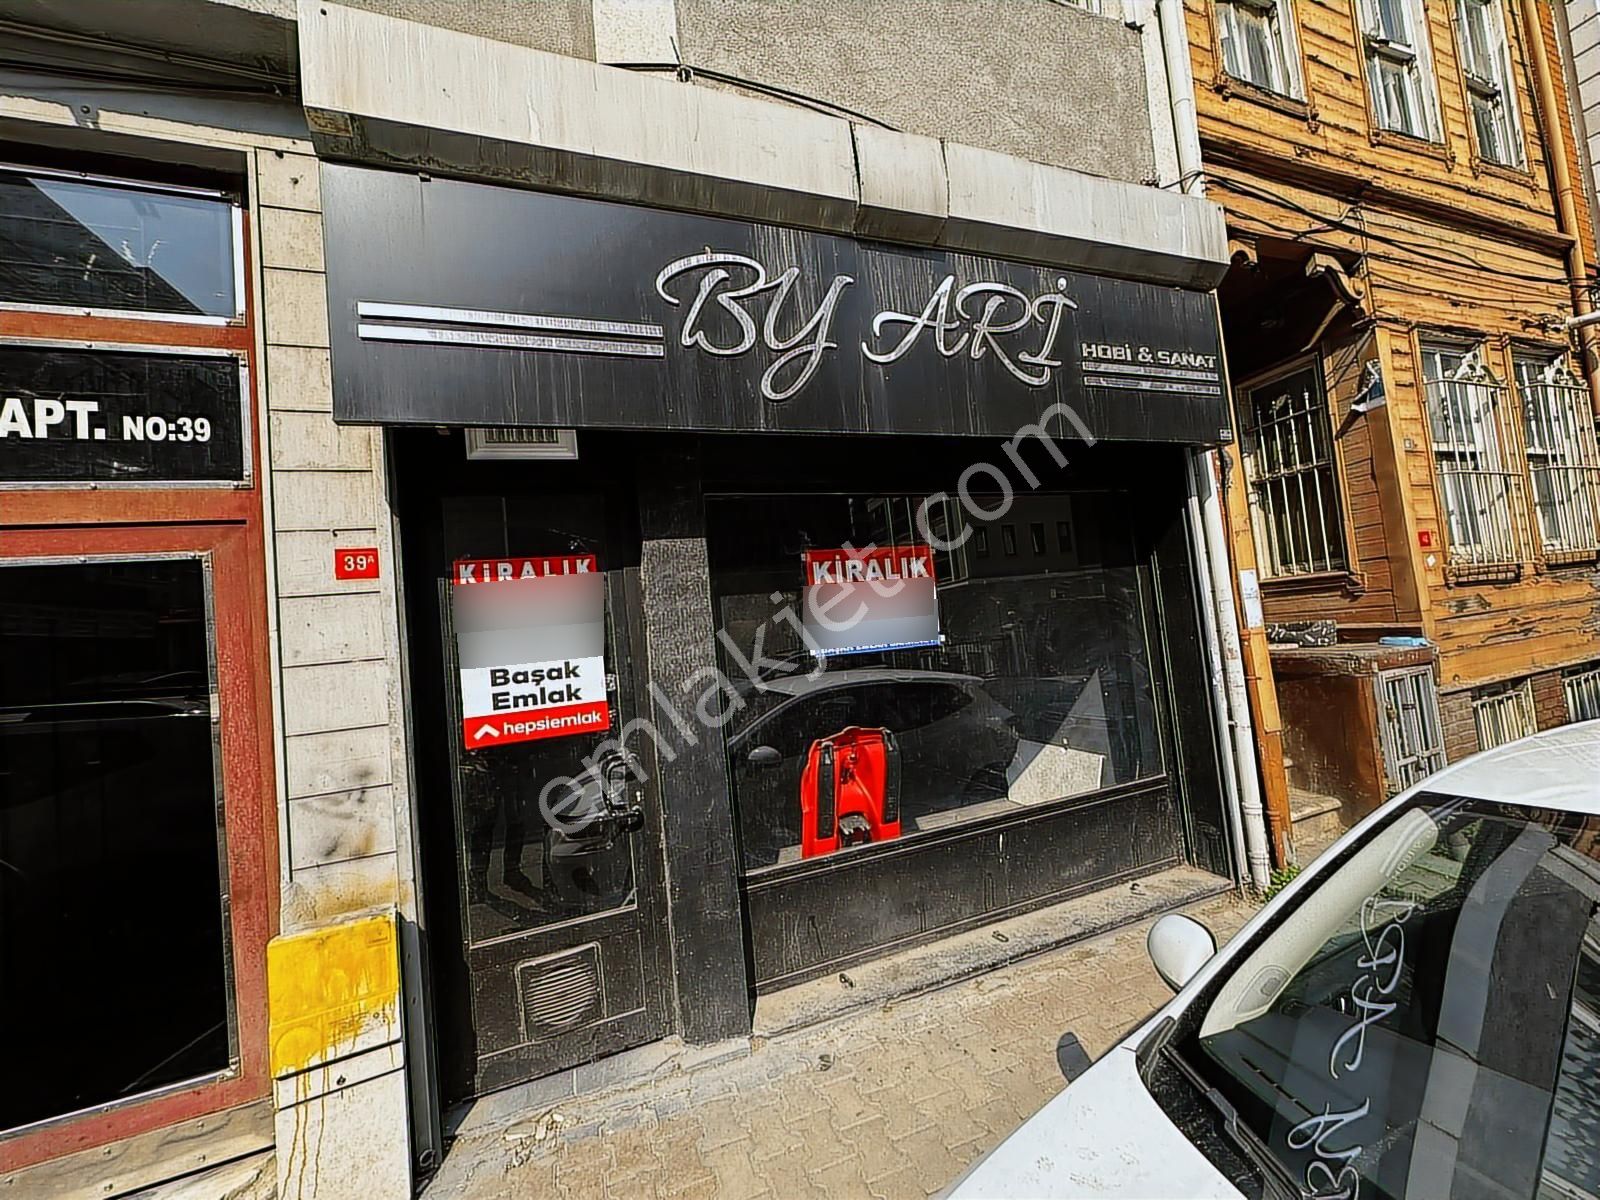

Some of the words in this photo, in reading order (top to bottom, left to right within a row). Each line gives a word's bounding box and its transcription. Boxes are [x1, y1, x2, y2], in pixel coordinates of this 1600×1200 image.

[655, 252, 855, 401] BY
[861, 276, 1079, 387] ARİ
[1137, 346, 1154, 363] &
[1157, 350, 1217, 368] SANAT
[0, 397, 106, 440] APT.
[122, 415, 211, 442] NO:39
[812, 554, 930, 586] KİRALIK
[489, 660, 582, 688] Başak
[491, 683, 583, 712] Emlak
[502, 709, 603, 737] hepsiemlak
